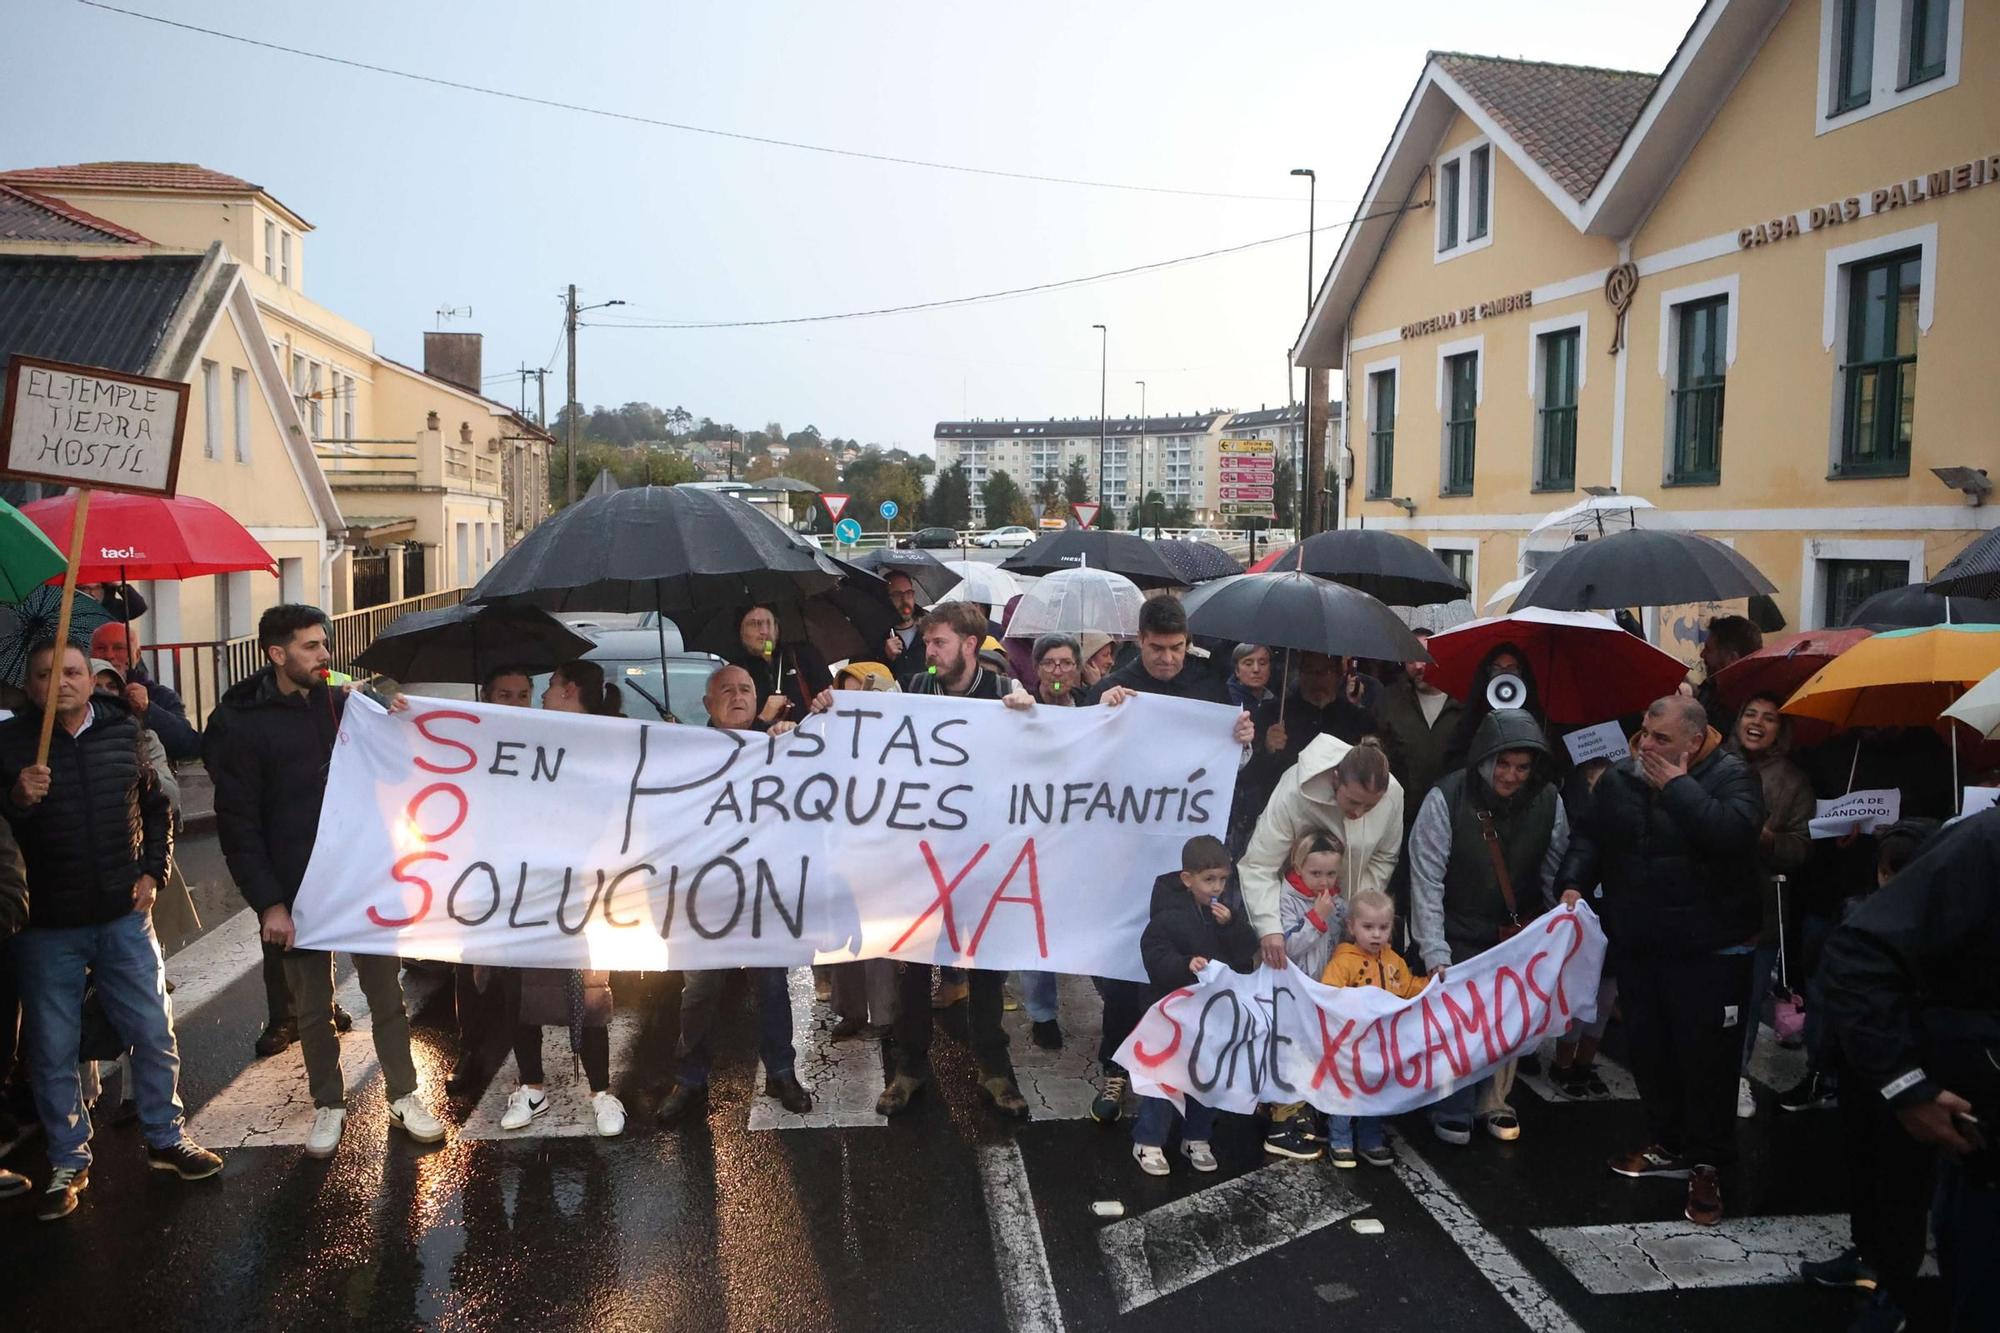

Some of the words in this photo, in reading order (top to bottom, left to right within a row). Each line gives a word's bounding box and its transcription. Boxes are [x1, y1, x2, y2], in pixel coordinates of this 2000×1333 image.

[1738, 215, 1800, 249] CASA
[1809, 198, 1860, 229] DAS
[1400, 311, 1457, 340] CONCELLO
[1460, 306, 1476, 324] DE
[1480, 290, 1532, 318] CAMBRE
[49, 404, 152, 441] TIERRA
[1008, 767, 1213, 824] INFANTÍS
[889, 837, 1048, 958] XA
